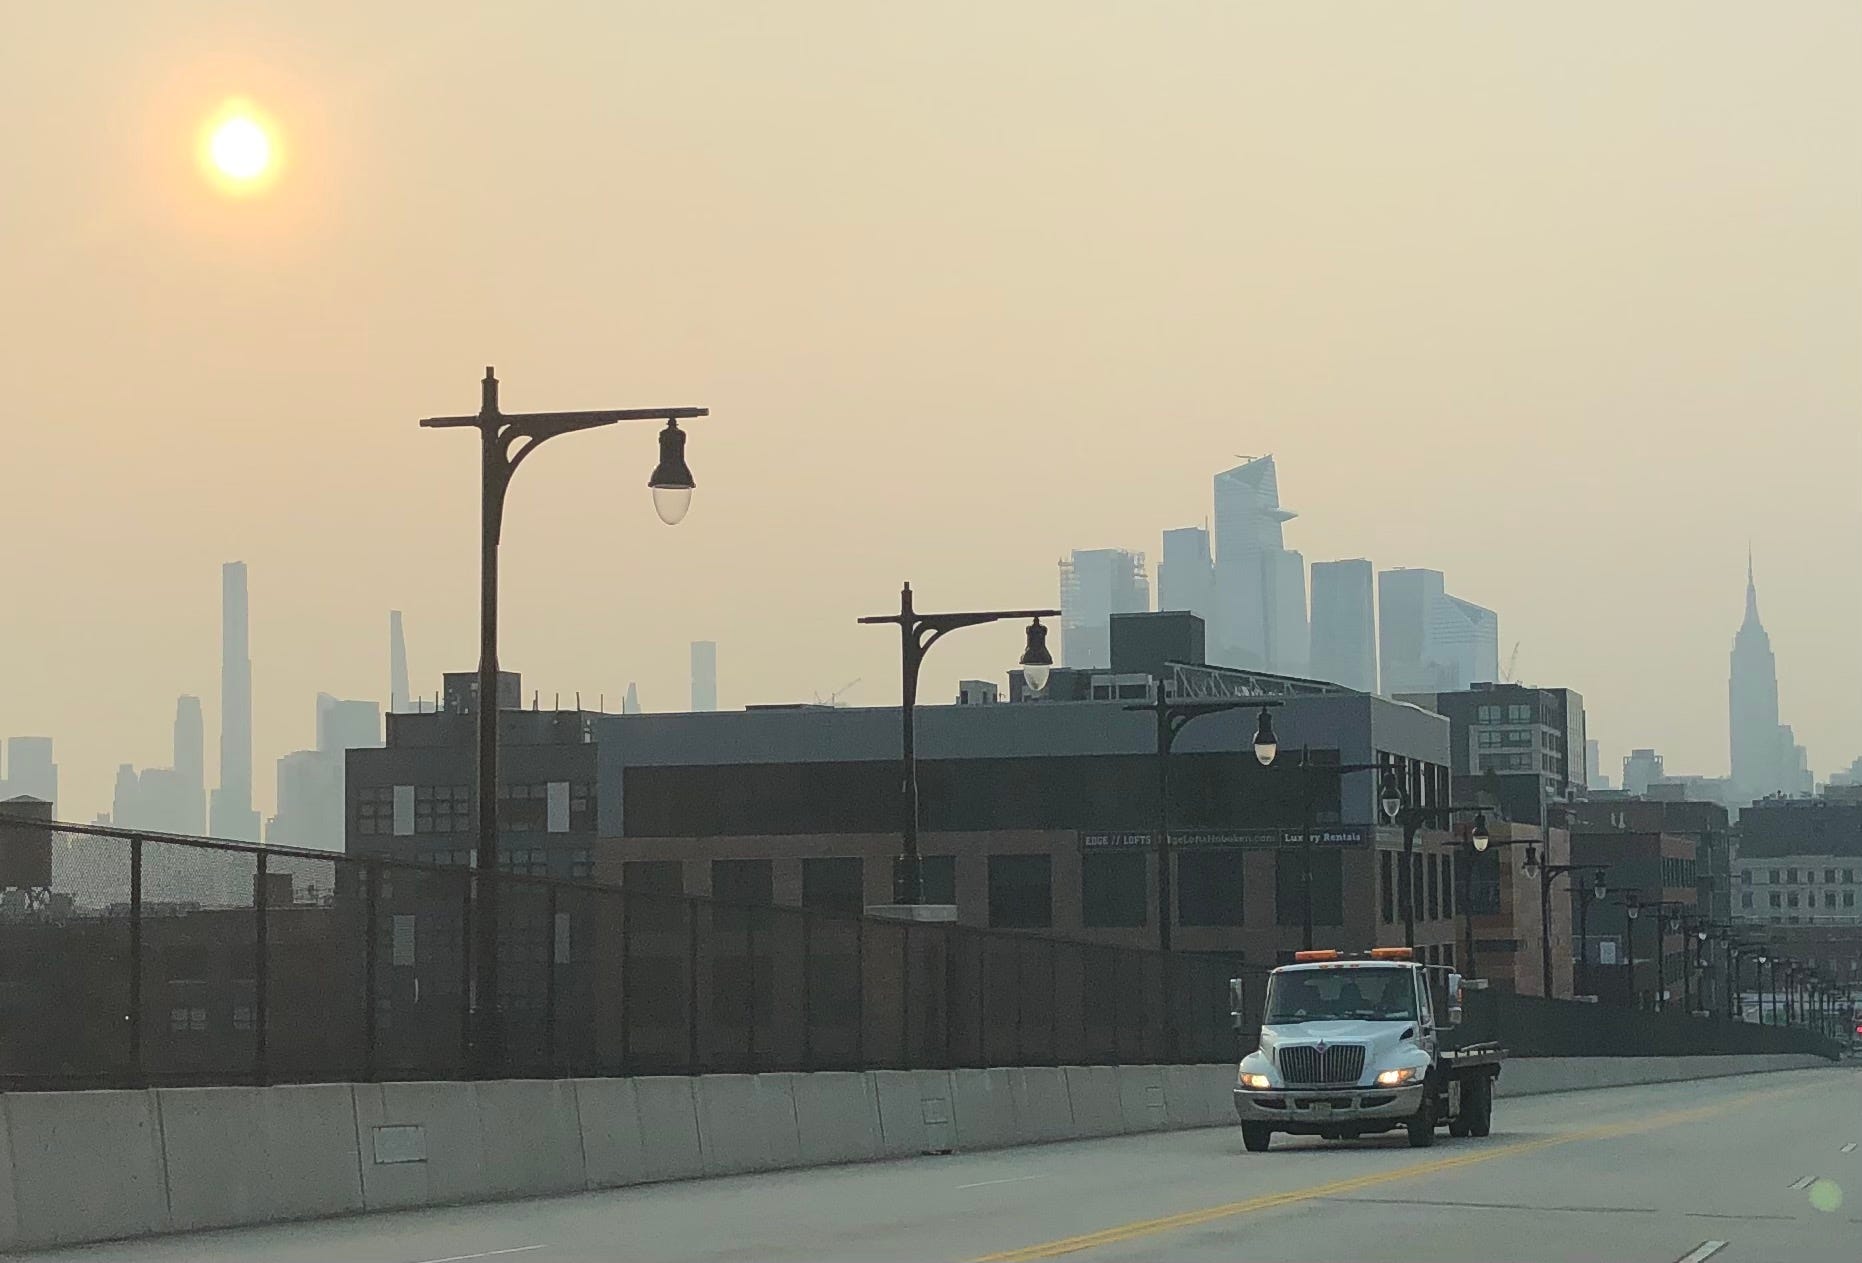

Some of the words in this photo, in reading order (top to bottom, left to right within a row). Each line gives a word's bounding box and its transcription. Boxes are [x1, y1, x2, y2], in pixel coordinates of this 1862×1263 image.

[1085, 836, 1109, 846] EDGE
[1123, 835, 1152, 845] LOFTS
[1284, 833, 1321, 844] Luxry
[1323, 832, 1362, 842] Rentals
